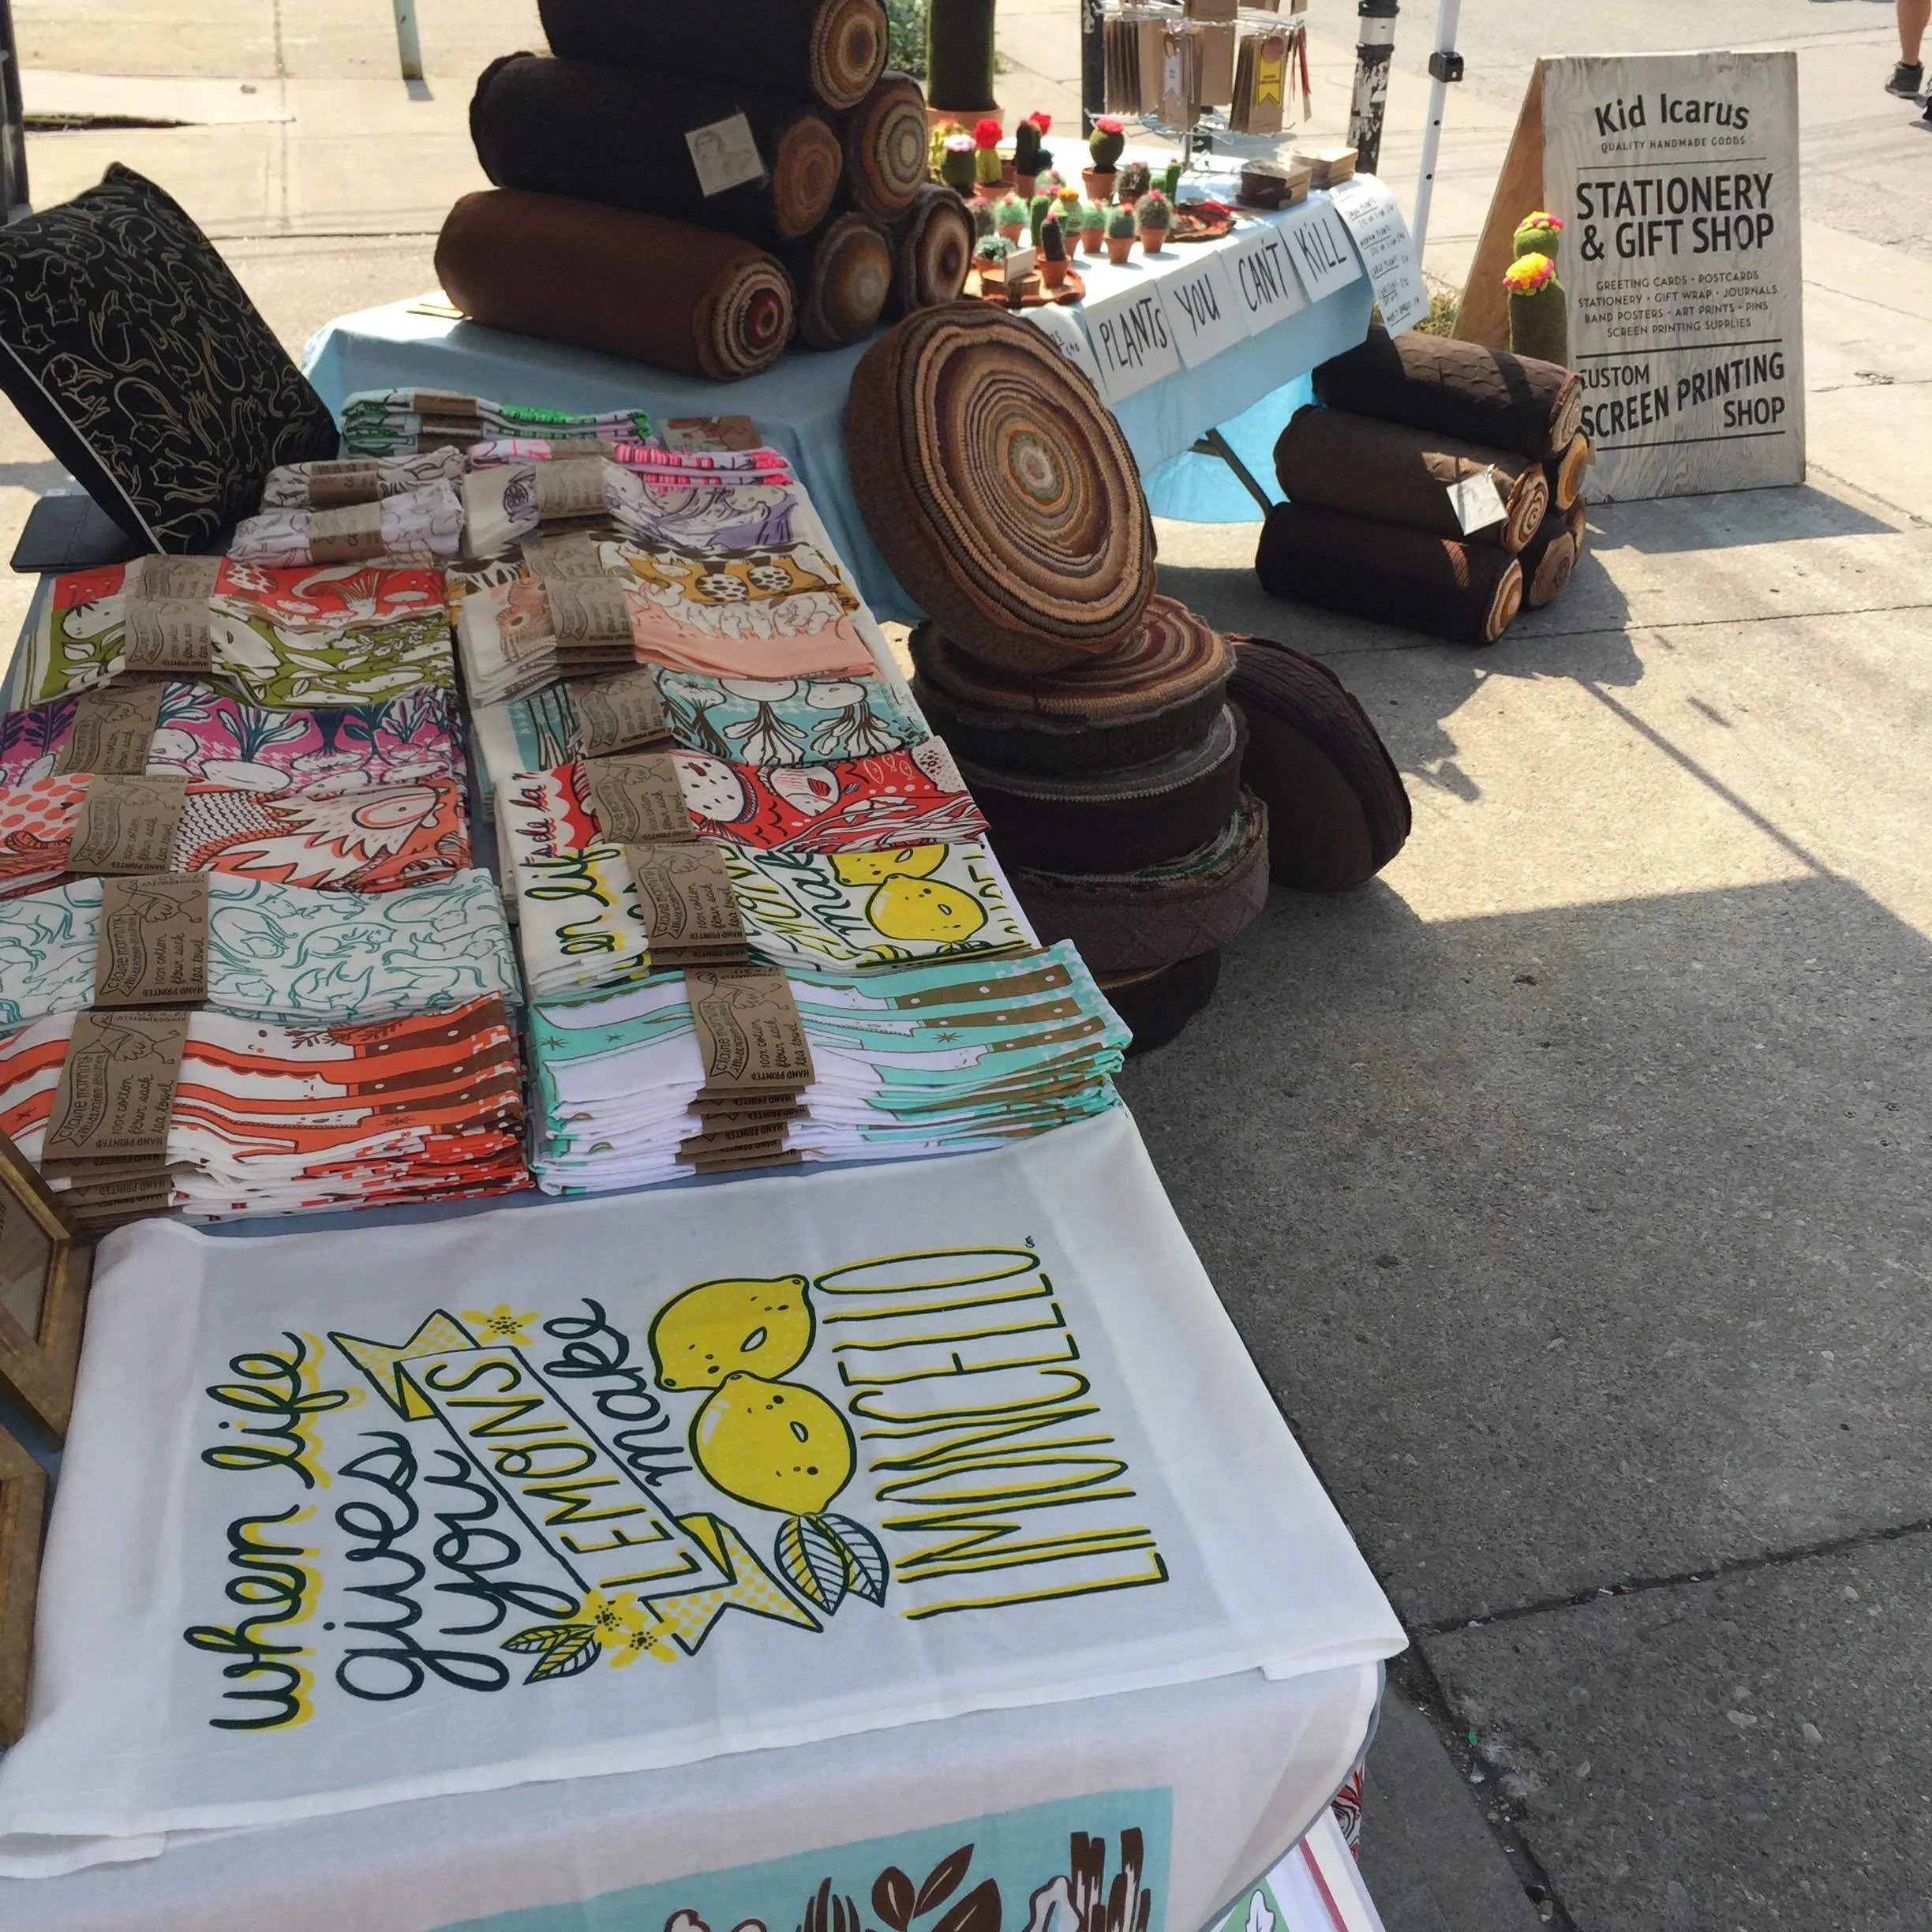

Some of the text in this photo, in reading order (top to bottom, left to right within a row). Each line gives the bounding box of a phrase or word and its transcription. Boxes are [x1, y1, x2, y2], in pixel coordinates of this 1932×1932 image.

[1595, 93, 1750, 137] Kid Icarus
[1601, 135, 1746, 153] QUALITY HANDMADE GOODS
[1576, 172, 1773, 220] STATIONERY
[1581, 212, 1774, 261] & GIFT SHOP
[1578, 285, 1778, 309] STATIONERY GIFT WRAP JOURNALS
[1597, 271, 1759, 291] GREETING CARDS POSTCARDS
[1099, 297, 1168, 373] PLANTS
[1174, 274, 1221, 337] YOU
[1585, 301, 1768, 324] BAND POSTERS ART PRINTS PINS
[1607, 318, 1751, 338] SCREEN PRINTING SUPPLIES
[1581, 352, 1784, 437] SCREEN PRINTING
[1724, 396, 1785, 429] SHOP
[687, 882, 702, 910] cotton
[701, 882, 724, 929] flour sack
[717, 885, 739, 929] tea towel
[153, 934, 167, 964] cotton
[169, 933, 185, 985] flour sack
[189, 937, 204, 983] tea towel
[142, 987, 203, 997] HAND PRINTED
[751, 1019, 770, 1068] 100% cotton
[764, 1017, 791, 1068] flour sack
[784, 1022, 807, 1067] tea towel
[751, 1069, 809, 1080] HAND PRINTED
[111, 1075, 133, 1135] 100% cotton
[128, 1073, 152, 1134] flour sack
[151, 1080, 174, 1134] tea towel
[769, 1095, 792, 1103] HAND
[95, 1136, 163, 1148] HAND PRINTED
[724, 1123, 783, 1140] HAND PRINTED
[99, 1179, 165, 1196] HAND PRINTED
[541, 1296, 695, 1490] make
[813, 1246, 1170, 1620] LIMONCELLO
[425, 1357, 704, 1593] LEMONS
[183, 1330, 365, 1730] when life
[423, 1448, 582, 1635] you
[322, 1429, 511, 1702] gives
